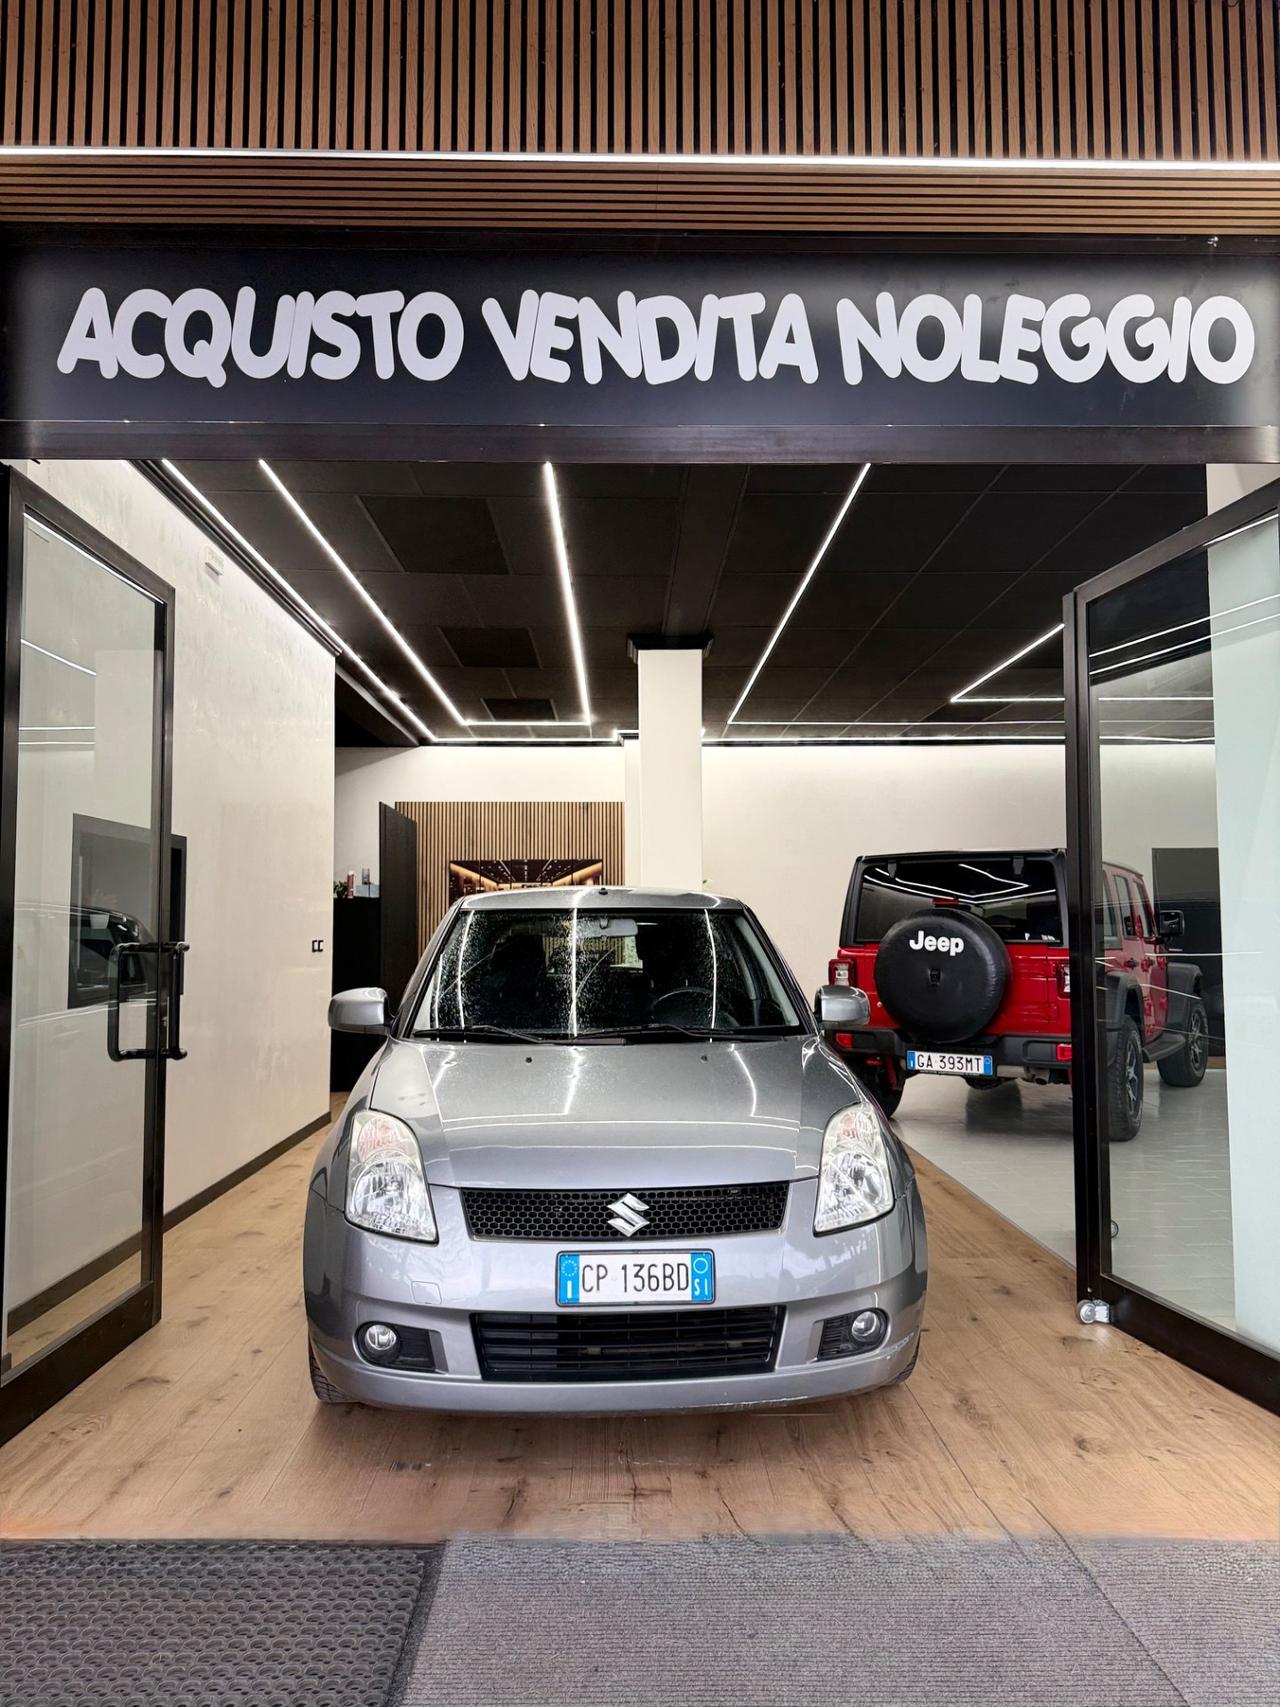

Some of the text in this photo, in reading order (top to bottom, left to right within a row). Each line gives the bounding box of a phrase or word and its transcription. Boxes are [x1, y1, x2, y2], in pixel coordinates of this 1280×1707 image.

[56, 286, 1255, 388] ACQUISTO VENDITA NOLEGGIO
[909, 930, 964, 956] Jeep
[917, 1054, 933, 1069] GA
[938, 1055, 982, 1072] 393MT
[582, 1264, 608, 1293] CP
[621, 1262, 689, 1293] 136BD
